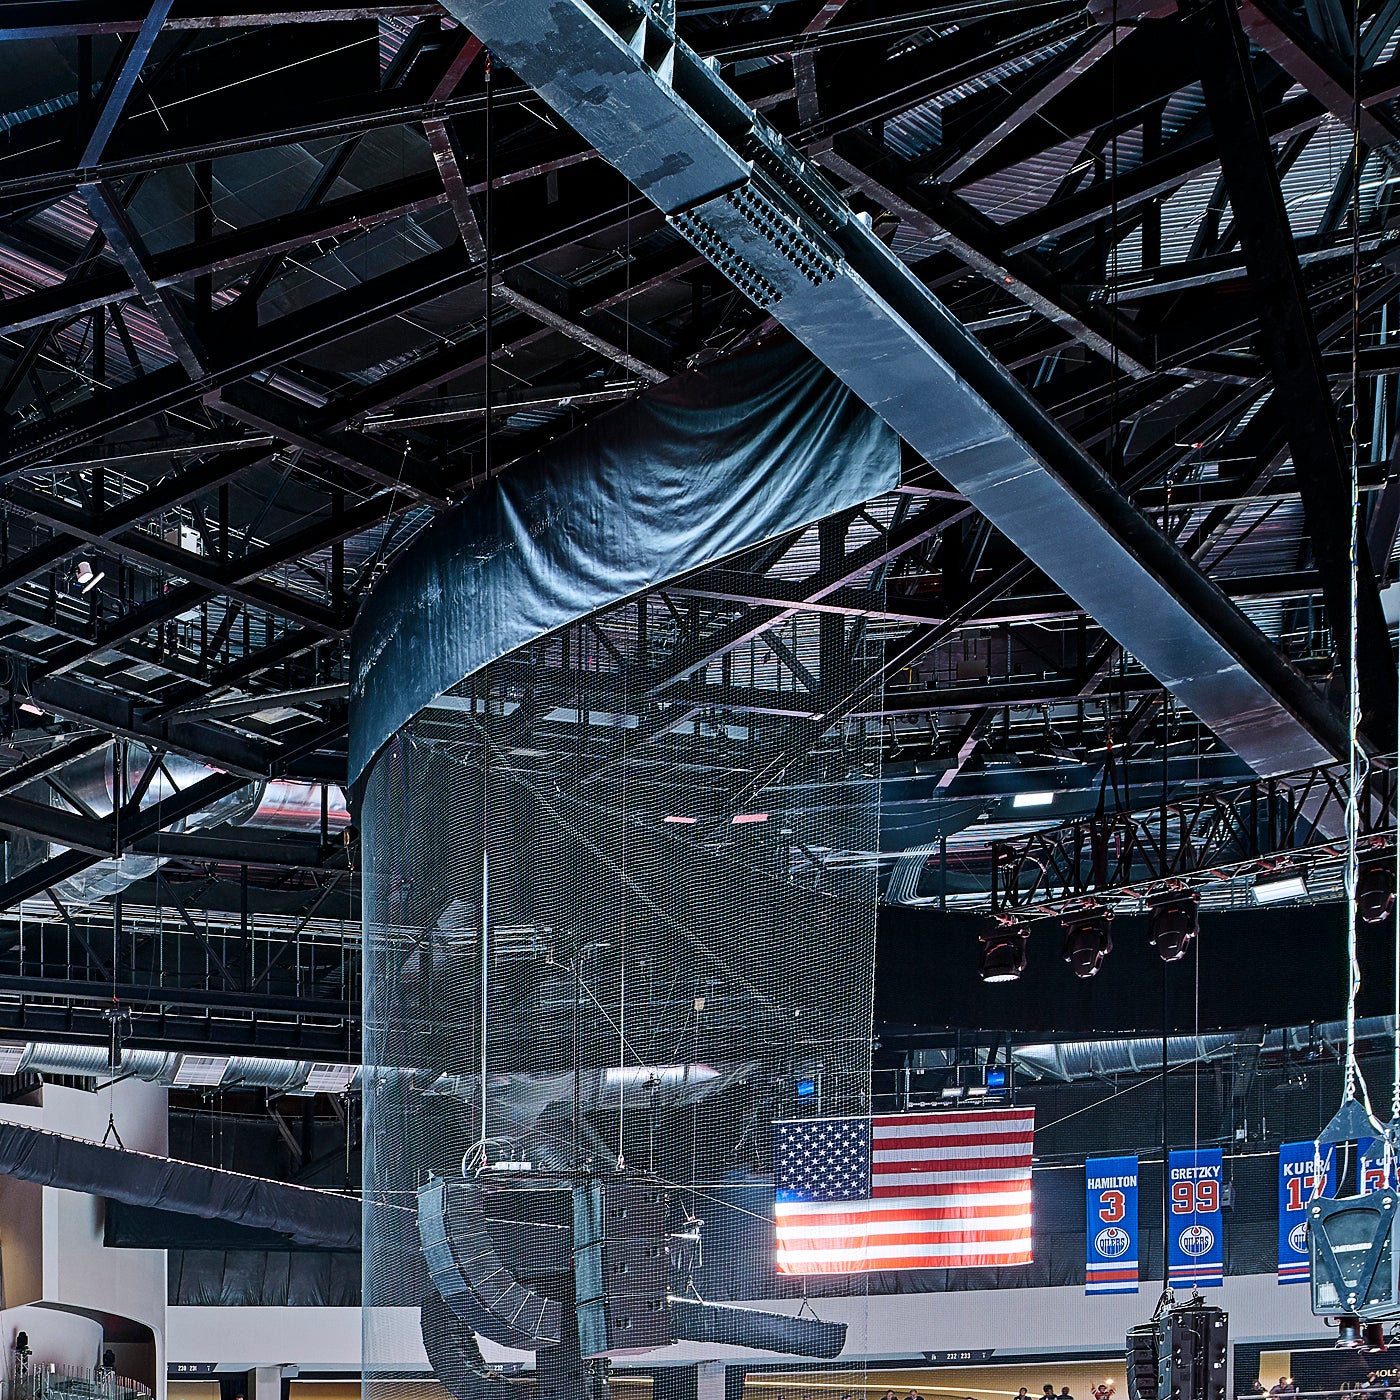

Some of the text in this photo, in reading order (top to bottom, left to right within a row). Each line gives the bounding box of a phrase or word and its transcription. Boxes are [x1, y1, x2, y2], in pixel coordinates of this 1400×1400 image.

[1087, 1175, 1137, 1190] HAMILTON
[1171, 1165, 1221, 1180] GRETZKY
[1099, 1190, 1126, 1223] 3
[1171, 1180, 1220, 1214] 99
